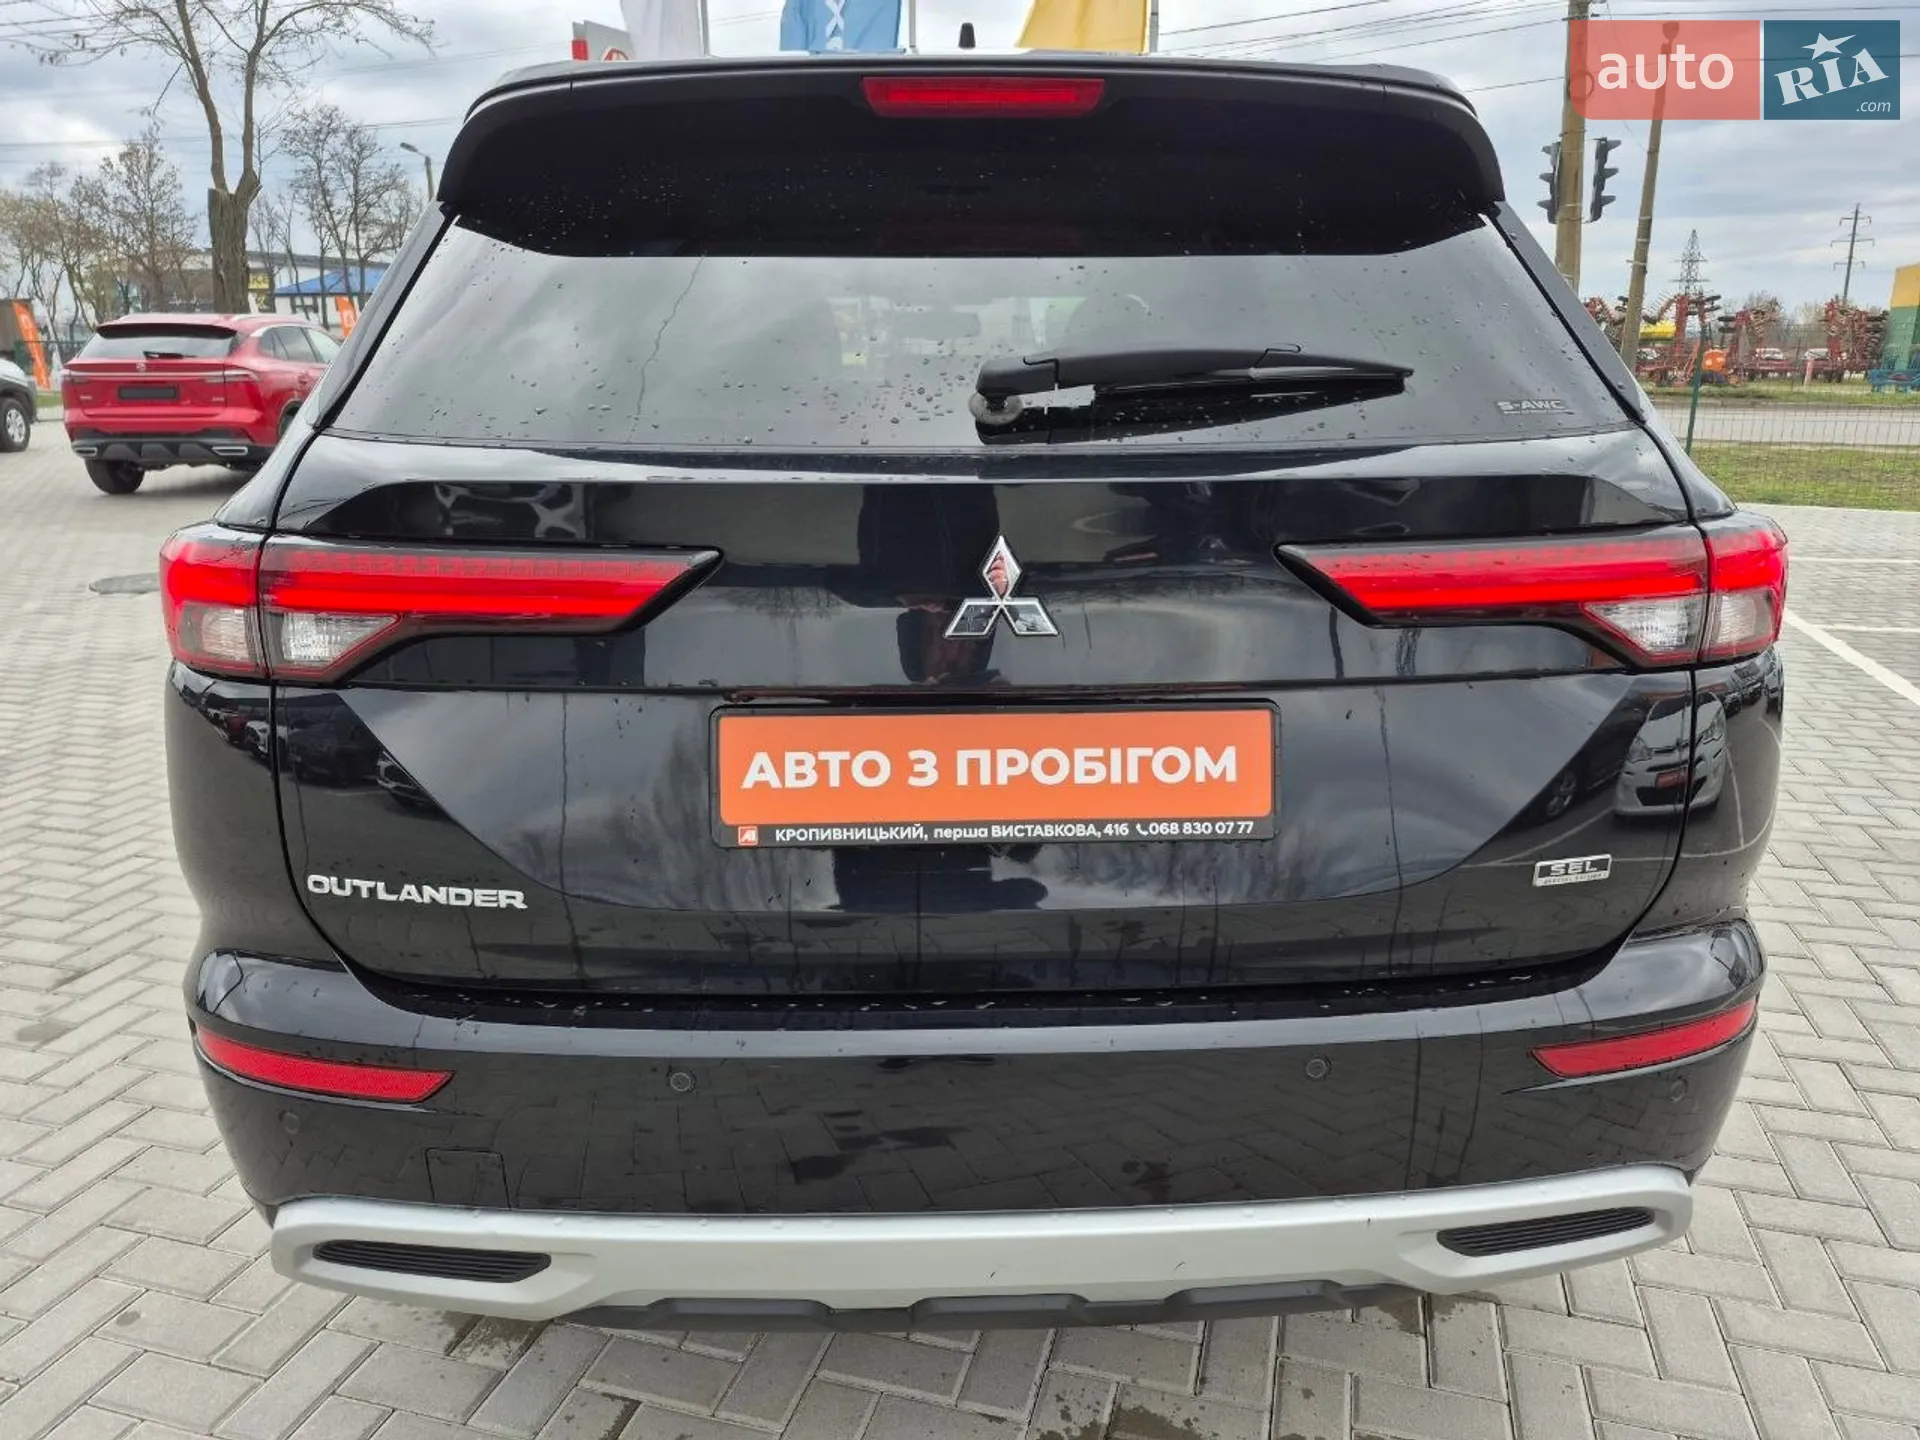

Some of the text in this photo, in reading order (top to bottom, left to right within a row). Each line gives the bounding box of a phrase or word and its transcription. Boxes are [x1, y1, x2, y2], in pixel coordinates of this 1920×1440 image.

[1497, 400, 1565, 411] S-AWC
[741, 750, 891, 789] АВТО
[955, 746, 1238, 786] ПРОБІГОМ
[774, 823, 929, 843] КРОПИВНИЦЬКИЙ,
[933, 829, 988, 841] перша
[991, 823, 1102, 839] ВИСТАВКОВА,
[1103, 823, 1130, 837] 416
[1148, 822, 1179, 836] 068
[1181, 821, 1213, 835] 830
[1214, 821, 1235, 834] 07
[1237, 821, 1255, 834] 77
[1549, 861, 1598, 876] SEL
[306, 873, 529, 909] OUTLANDER
